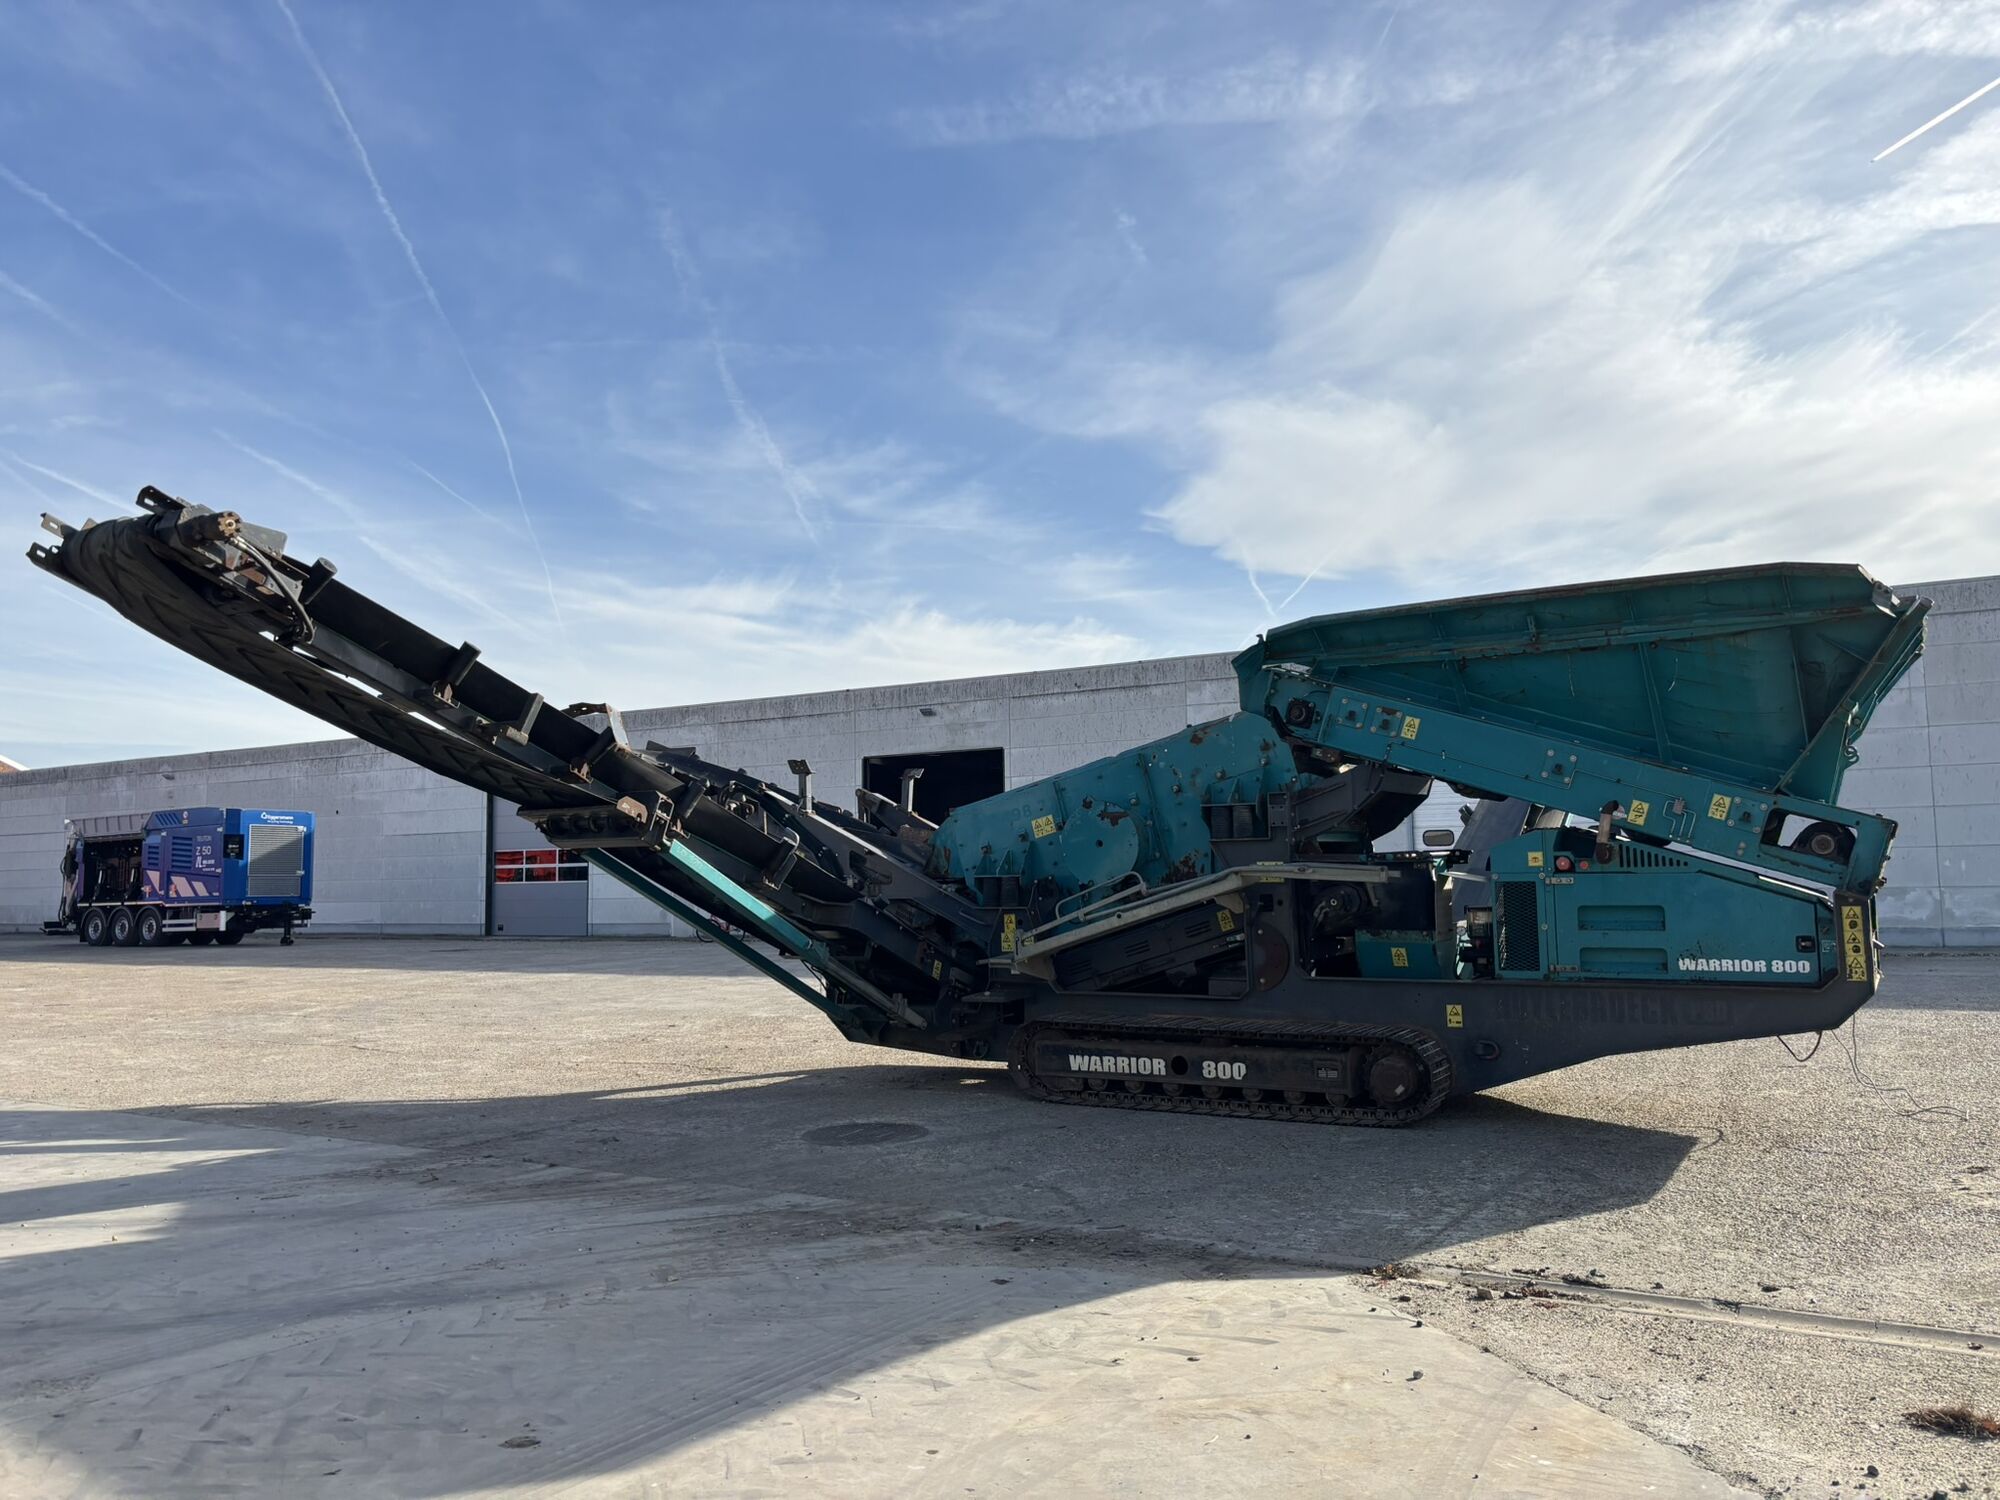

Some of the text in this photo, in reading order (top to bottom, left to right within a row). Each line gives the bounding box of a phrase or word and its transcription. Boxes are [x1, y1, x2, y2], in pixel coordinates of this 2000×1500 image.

[1678, 957, 1811, 974] WARRIOR 800
[1068, 1054, 1247, 1080] WARRIOR 800
